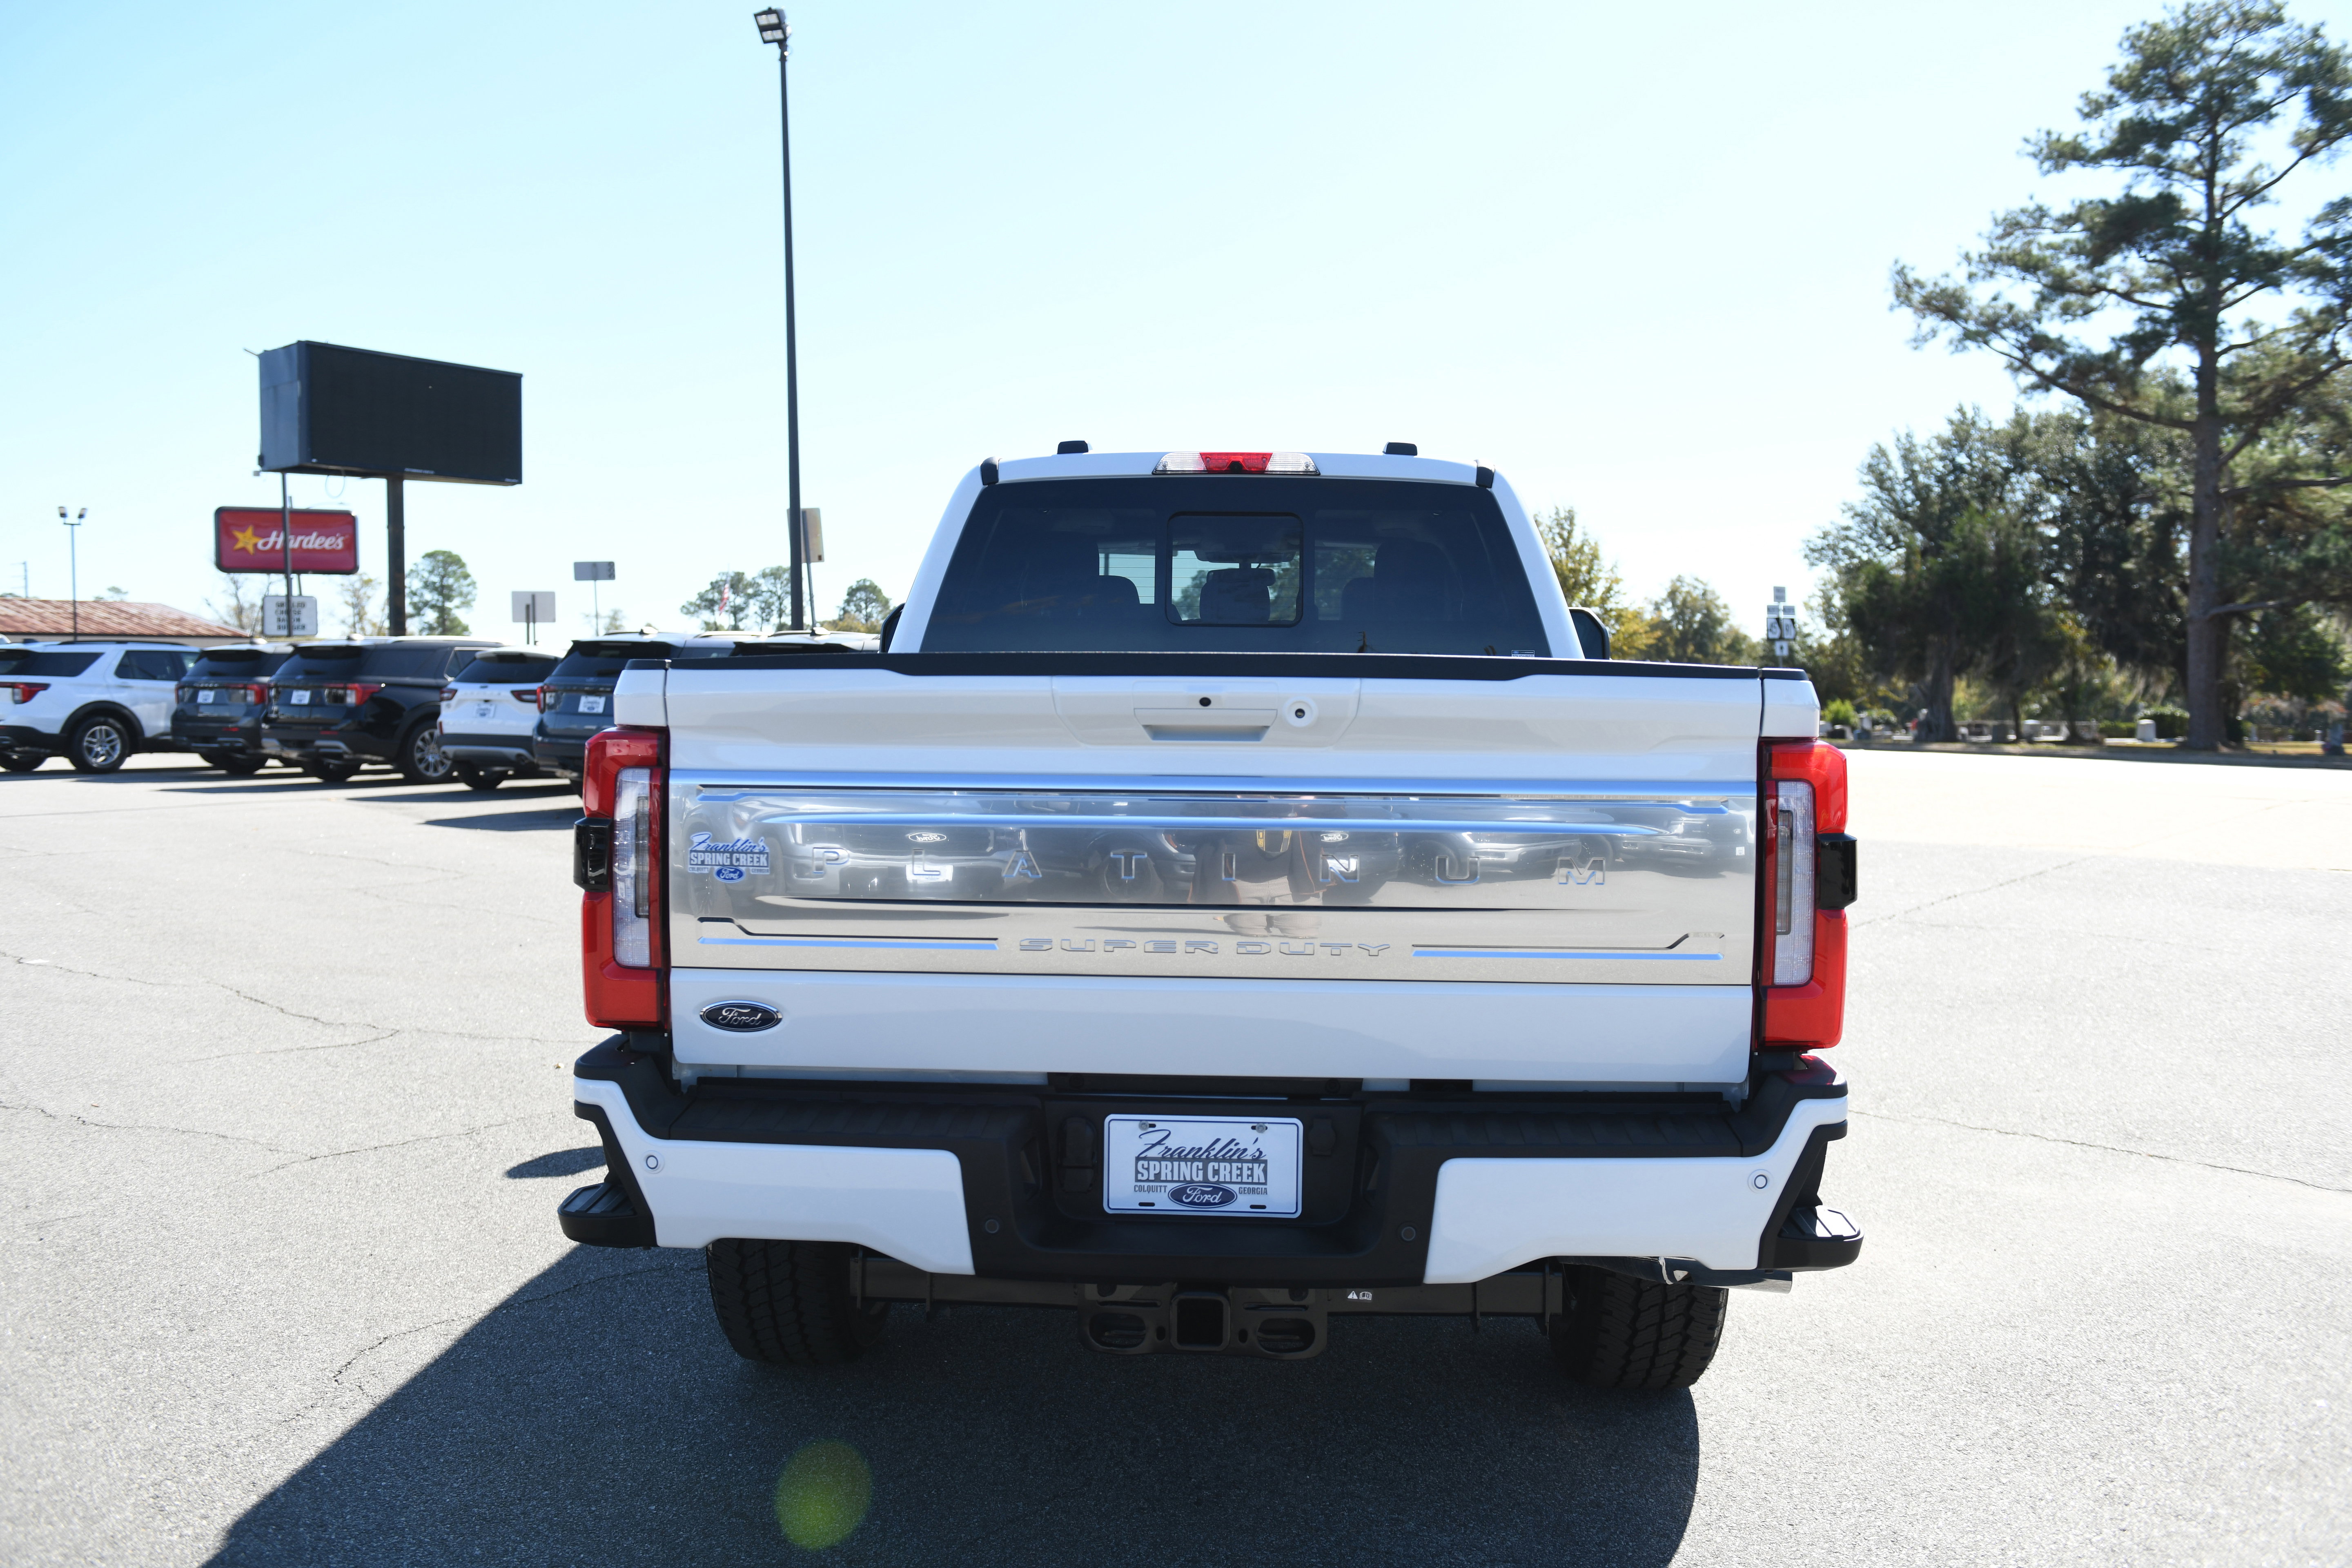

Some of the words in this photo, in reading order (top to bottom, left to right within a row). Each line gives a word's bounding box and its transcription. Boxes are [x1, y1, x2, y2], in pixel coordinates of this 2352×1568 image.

[690, 833, 768, 852] Franklin's
[690, 852, 730, 865] SPRING
[732, 853, 768, 866] CREEK
[813, 847, 1606, 885] PLATINUM
[719, 868, 739, 879] Ford
[1020, 938, 1218, 954] SUPER
[1236, 941, 1390, 957] DUTY
[718, 1007, 762, 1025] Ford
[1136, 1129, 1266, 1160] Franklin's
[1137, 1160, 1203, 1181] SPRING
[1207, 1162, 1265, 1183] CREEK
[1134, 1185, 1167, 1194] COLQUITT
[1183, 1187, 1221, 1203] Ford
[1238, 1187, 1267, 1195] GEORGIA
